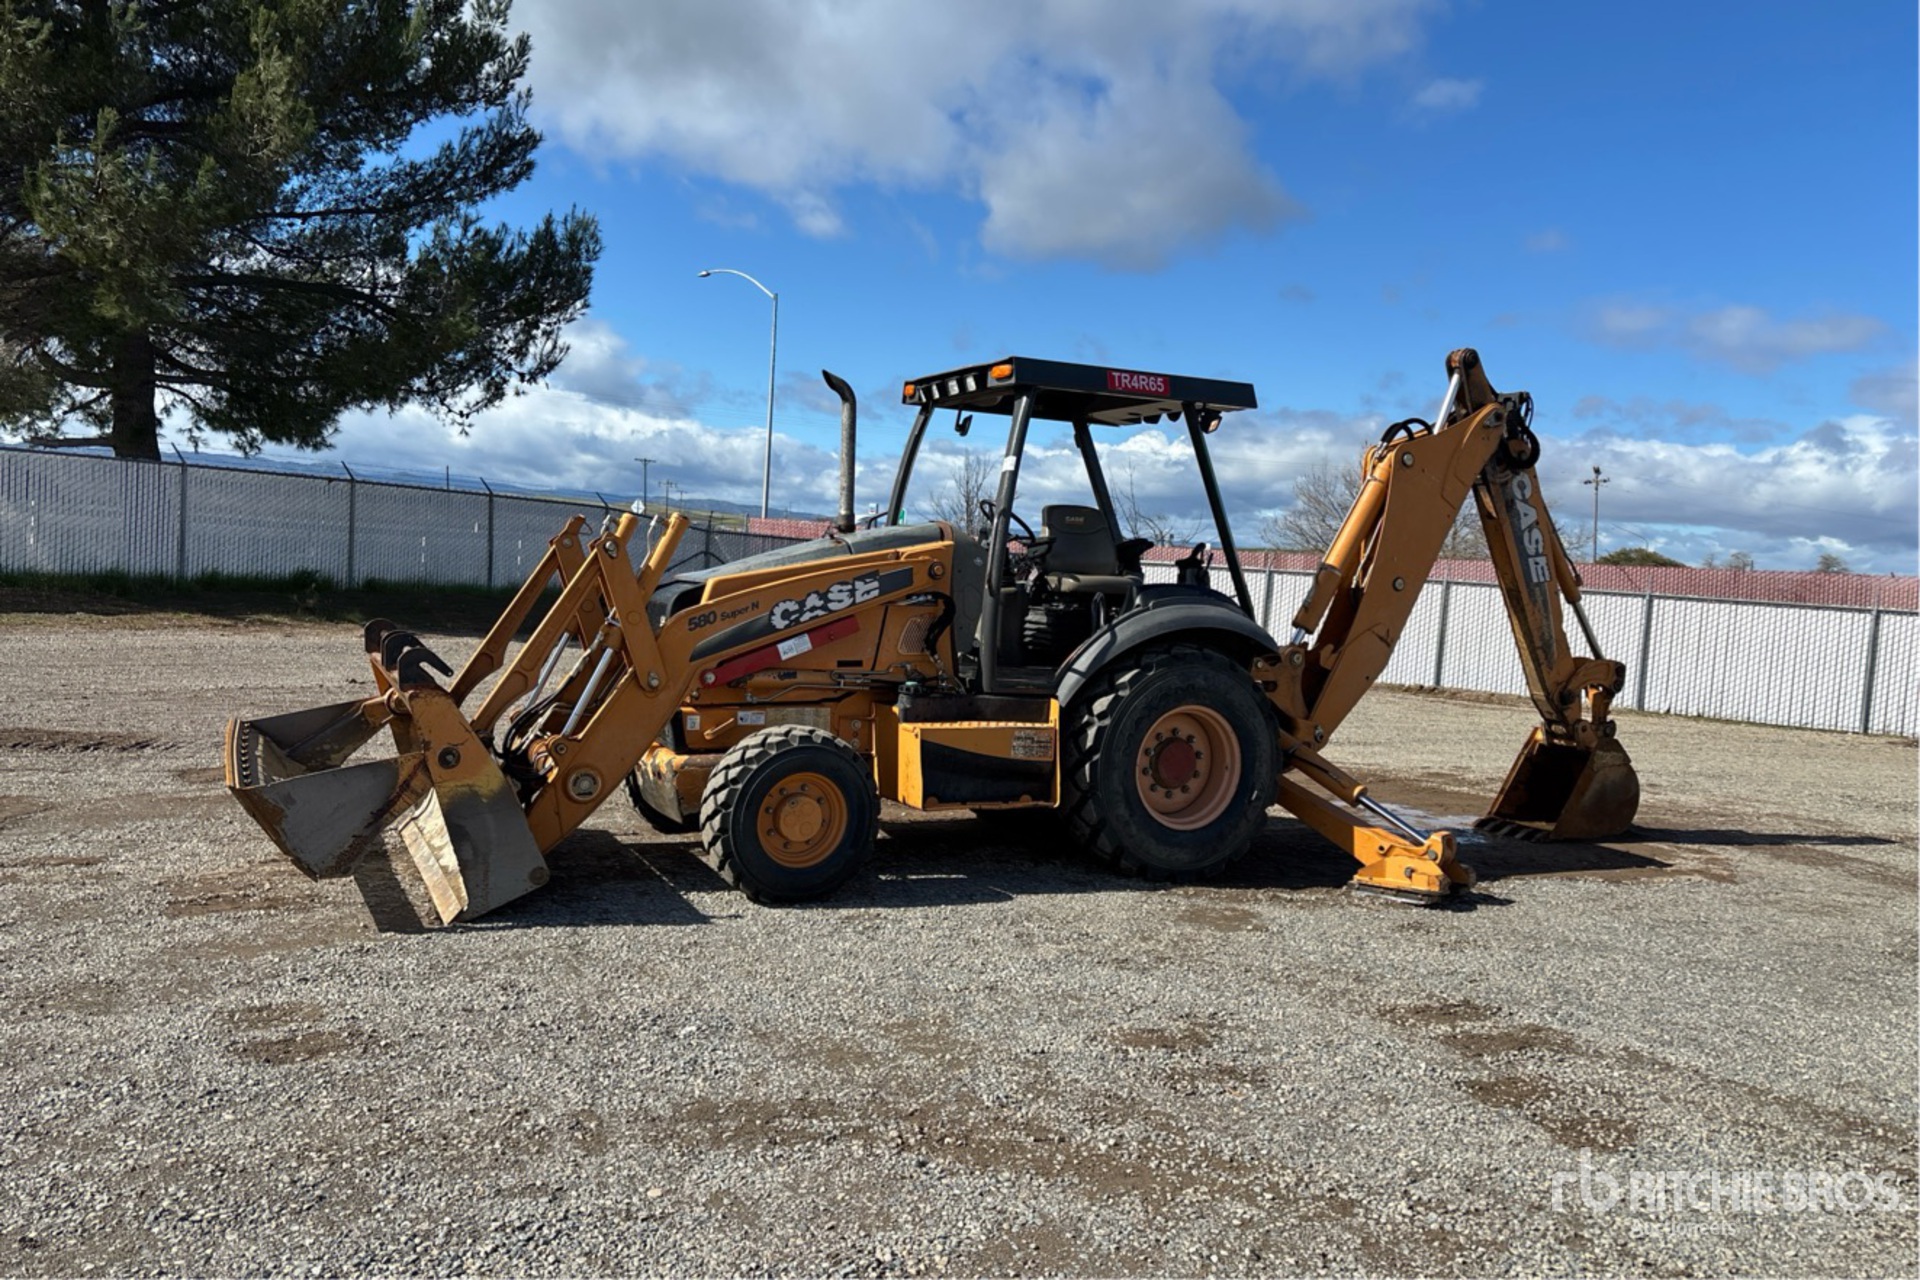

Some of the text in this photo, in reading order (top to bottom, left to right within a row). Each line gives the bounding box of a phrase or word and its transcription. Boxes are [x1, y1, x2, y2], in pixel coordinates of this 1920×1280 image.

[1112, 372, 1165, 393] TR4R65
[1511, 471, 1551, 583] CASE
[687, 601, 759, 631] 580 Super N
[770, 578, 880, 630] CASE
